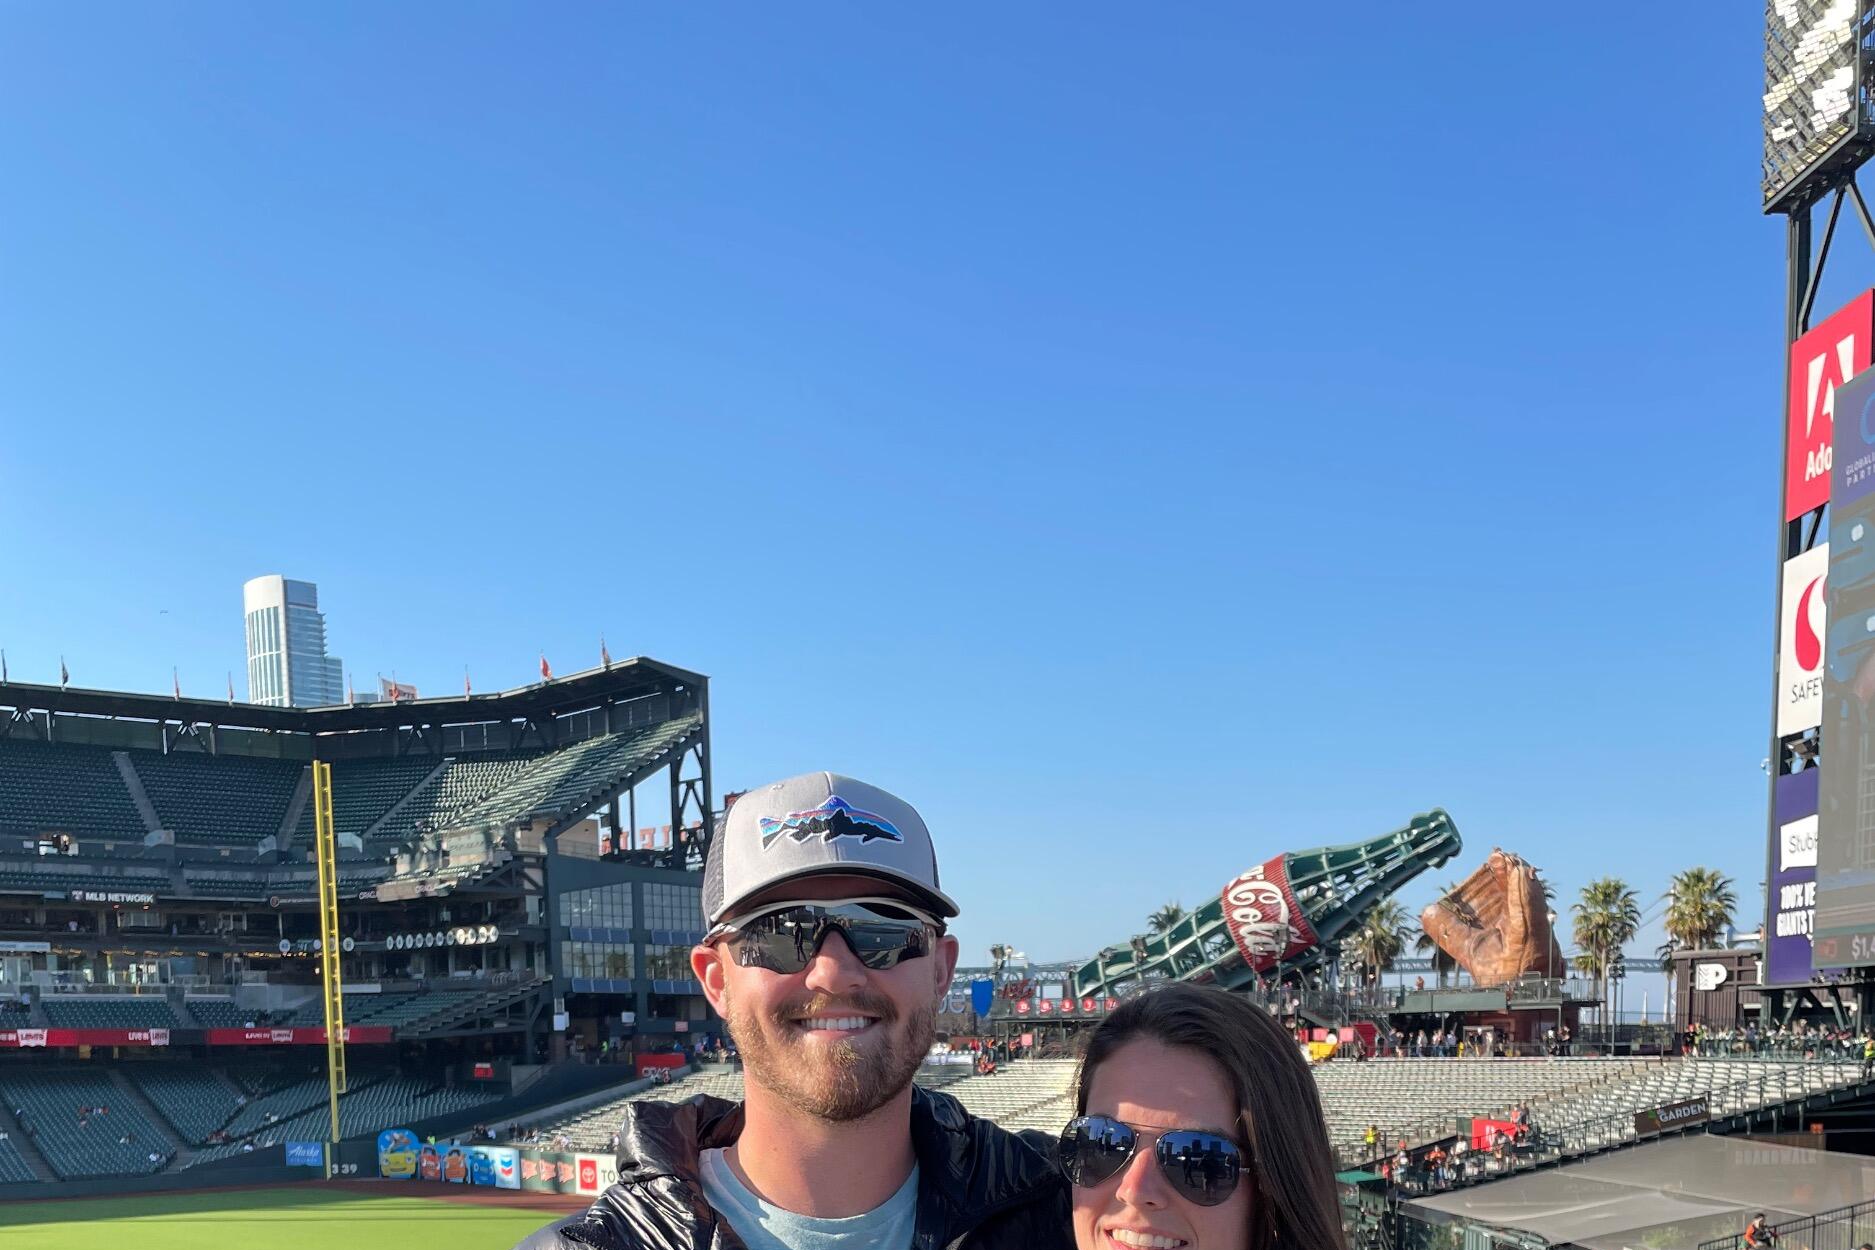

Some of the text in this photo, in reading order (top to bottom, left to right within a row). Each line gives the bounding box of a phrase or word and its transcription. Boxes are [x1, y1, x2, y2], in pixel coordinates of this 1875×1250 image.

[1805, 442, 1832, 481] Ado
[85, 892, 153, 902] MLB NETWORK
[1659, 1103, 1707, 1122] GARDEN
